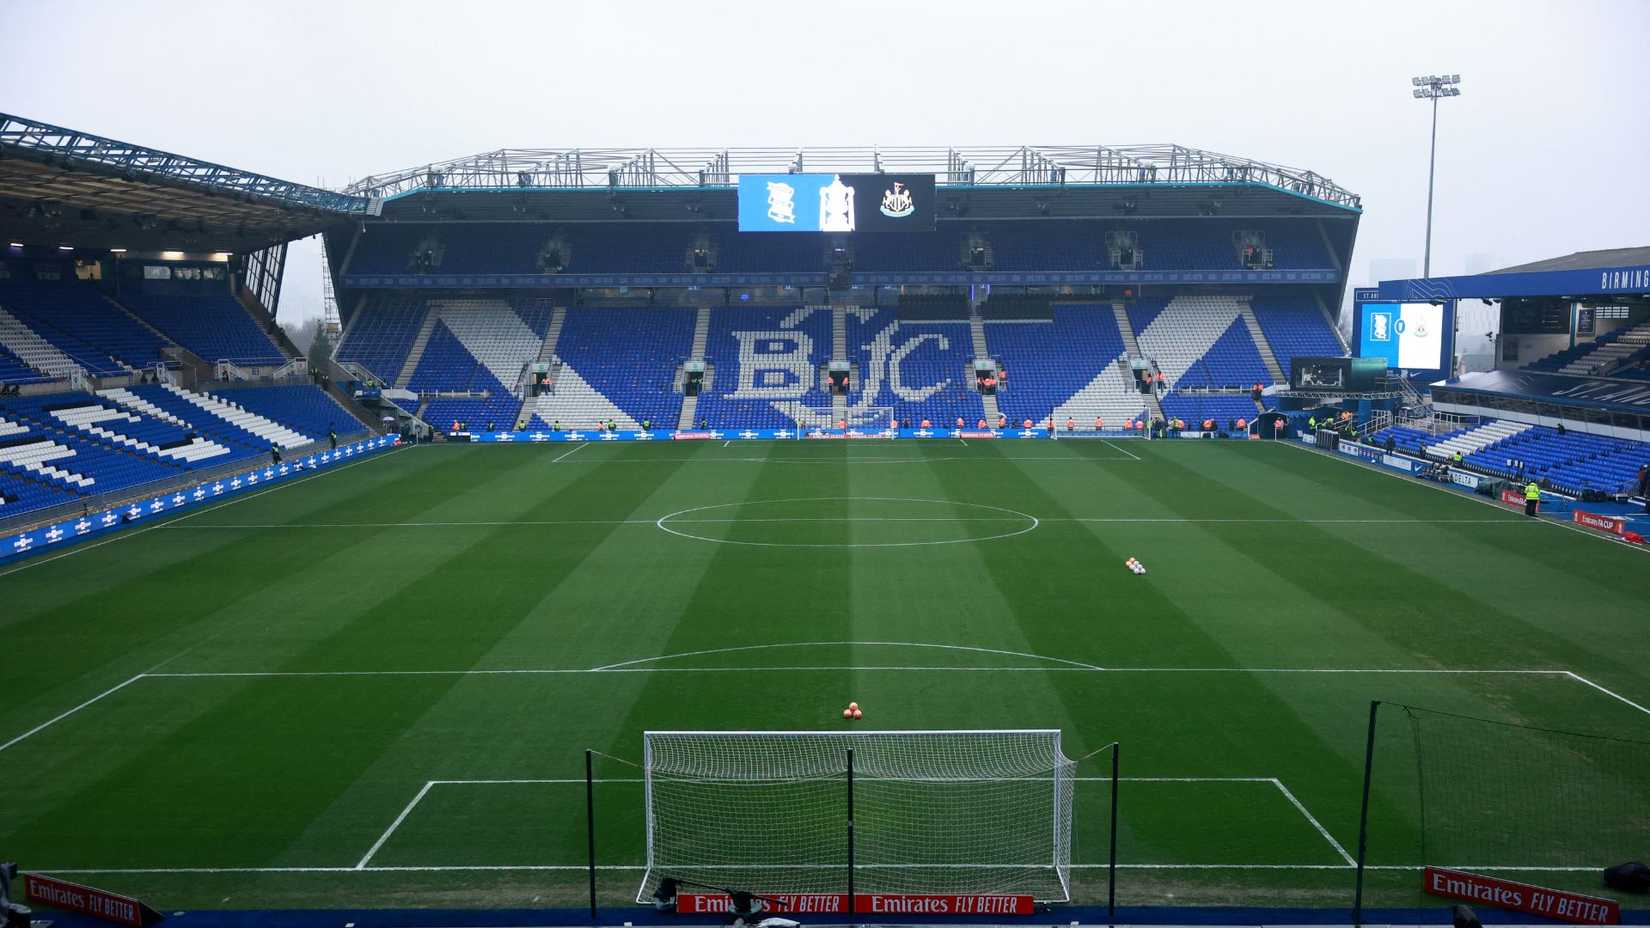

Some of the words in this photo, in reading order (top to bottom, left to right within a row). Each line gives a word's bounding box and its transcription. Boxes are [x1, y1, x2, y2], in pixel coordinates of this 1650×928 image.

[30, 879, 86, 908] Emirates
[89, 893, 103, 912] FLY
[104, 897, 134, 920] BETTER
[800, 895, 839, 912] BETTER
[872, 896, 948, 913] Emirates
[956, 896, 975, 913] FLY
[977, 897, 1017, 913] BETTER
[1432, 873, 1522, 906] Emirates
[1530, 892, 1554, 912] FLY
[1557, 899, 1609, 923] BETTER
